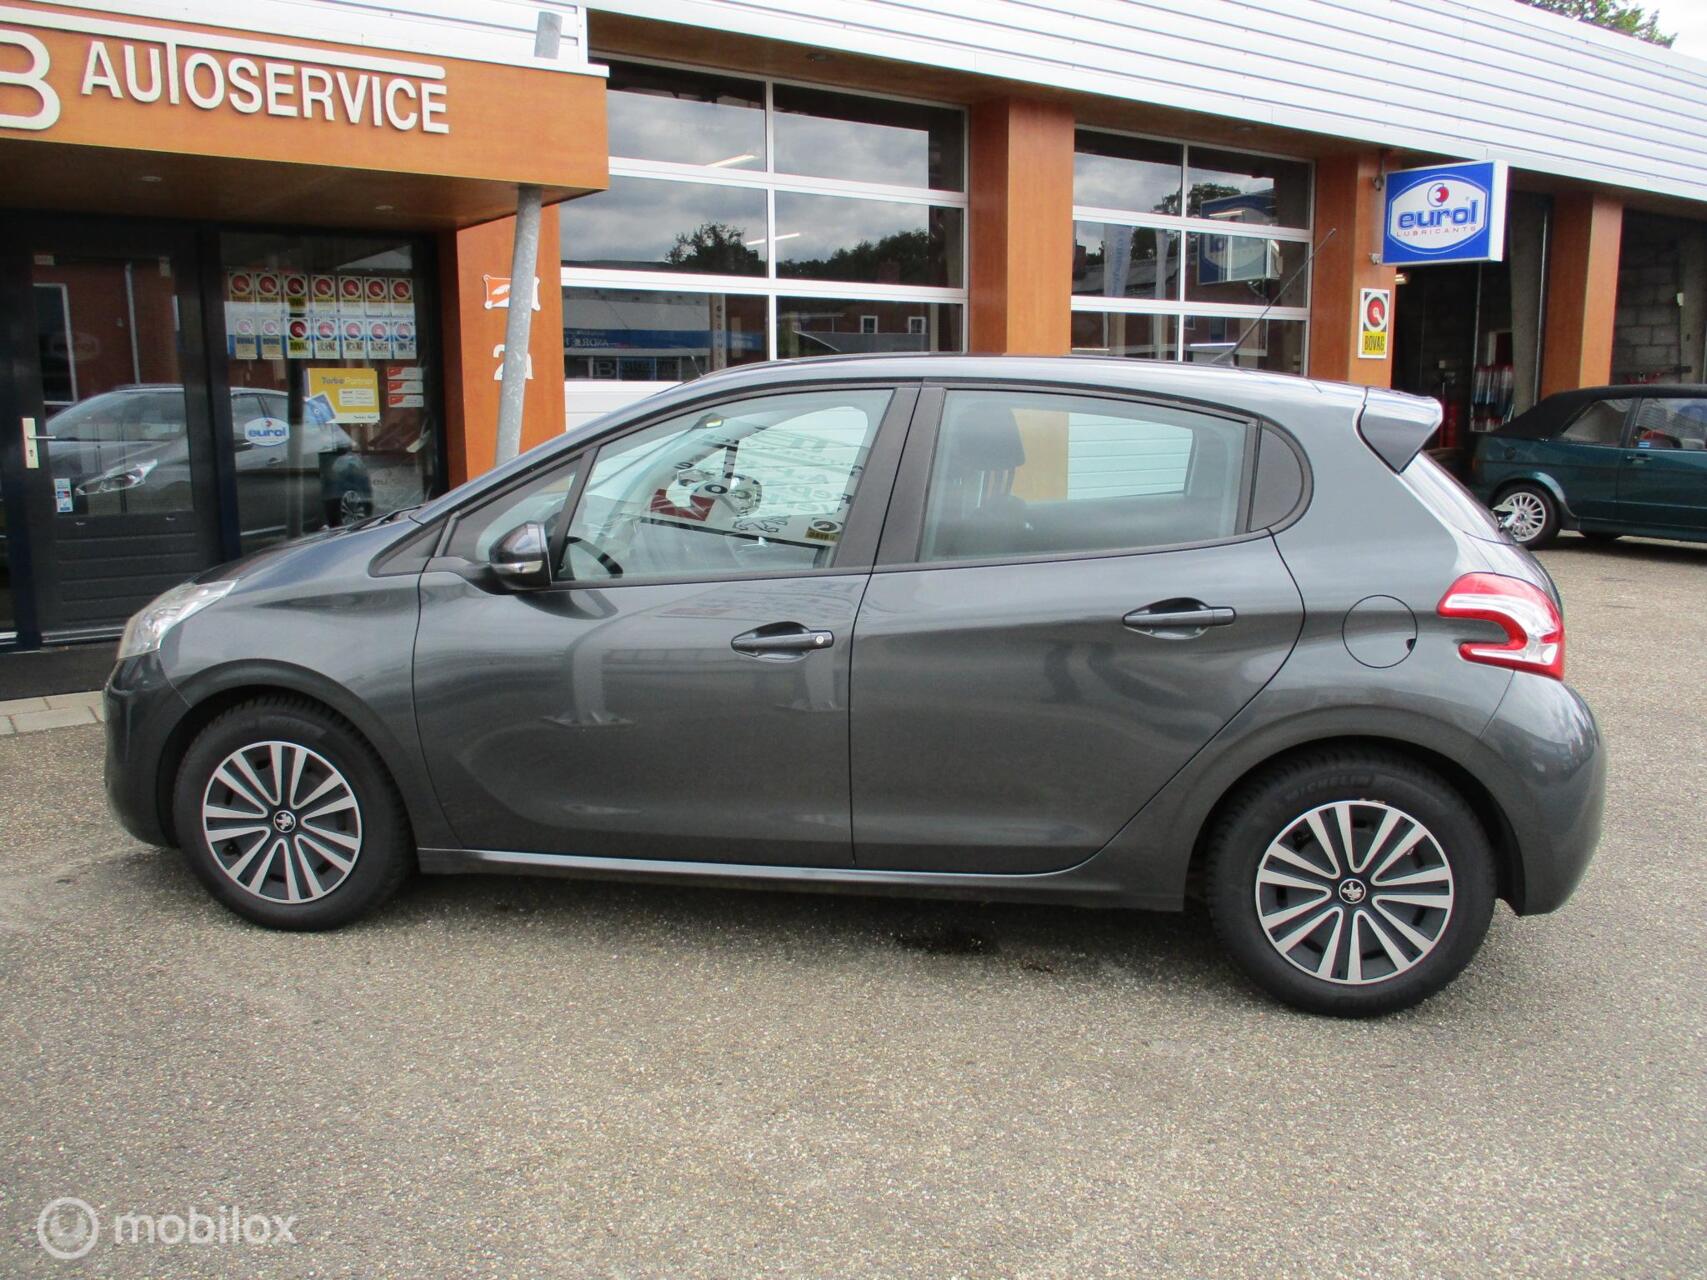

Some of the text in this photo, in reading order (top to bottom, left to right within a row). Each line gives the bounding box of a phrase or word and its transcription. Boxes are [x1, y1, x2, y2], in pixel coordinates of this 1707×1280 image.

[81, 40, 450, 134] AUTOSERVICE
[1398, 199, 1479, 230] eurol
[1396, 226, 1477, 238] LUBRICANTS
[1364, 335, 1385, 351] BOVAG
[248, 426, 287, 438] eurol
